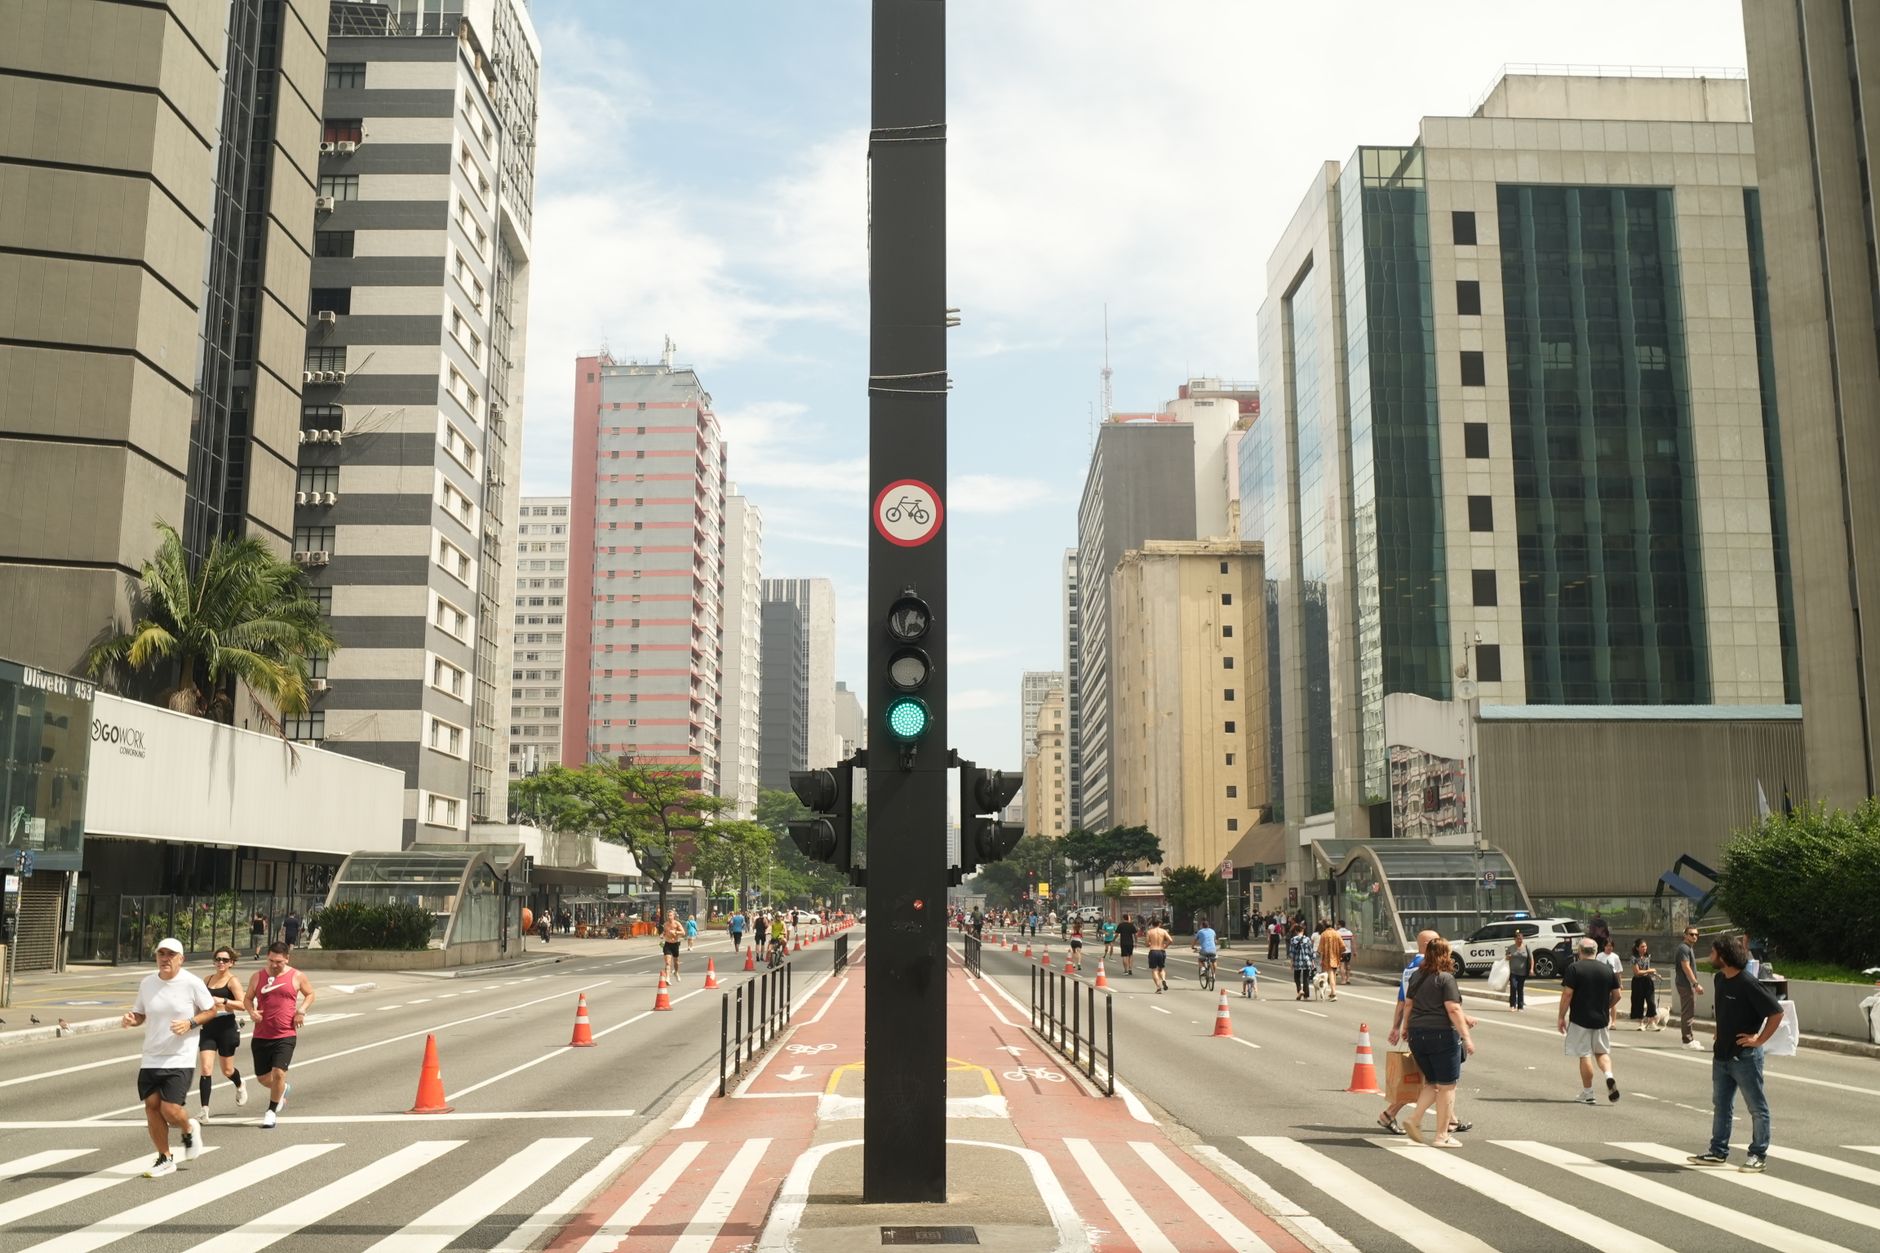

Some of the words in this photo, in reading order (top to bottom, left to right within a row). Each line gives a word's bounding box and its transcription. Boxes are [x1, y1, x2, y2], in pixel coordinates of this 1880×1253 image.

[23, 666, 68, 696] Olivetti
[74, 681, 93, 701] 453
[119, 746, 146, 759] COWORKING
[1469, 949, 1496, 958] GCM
